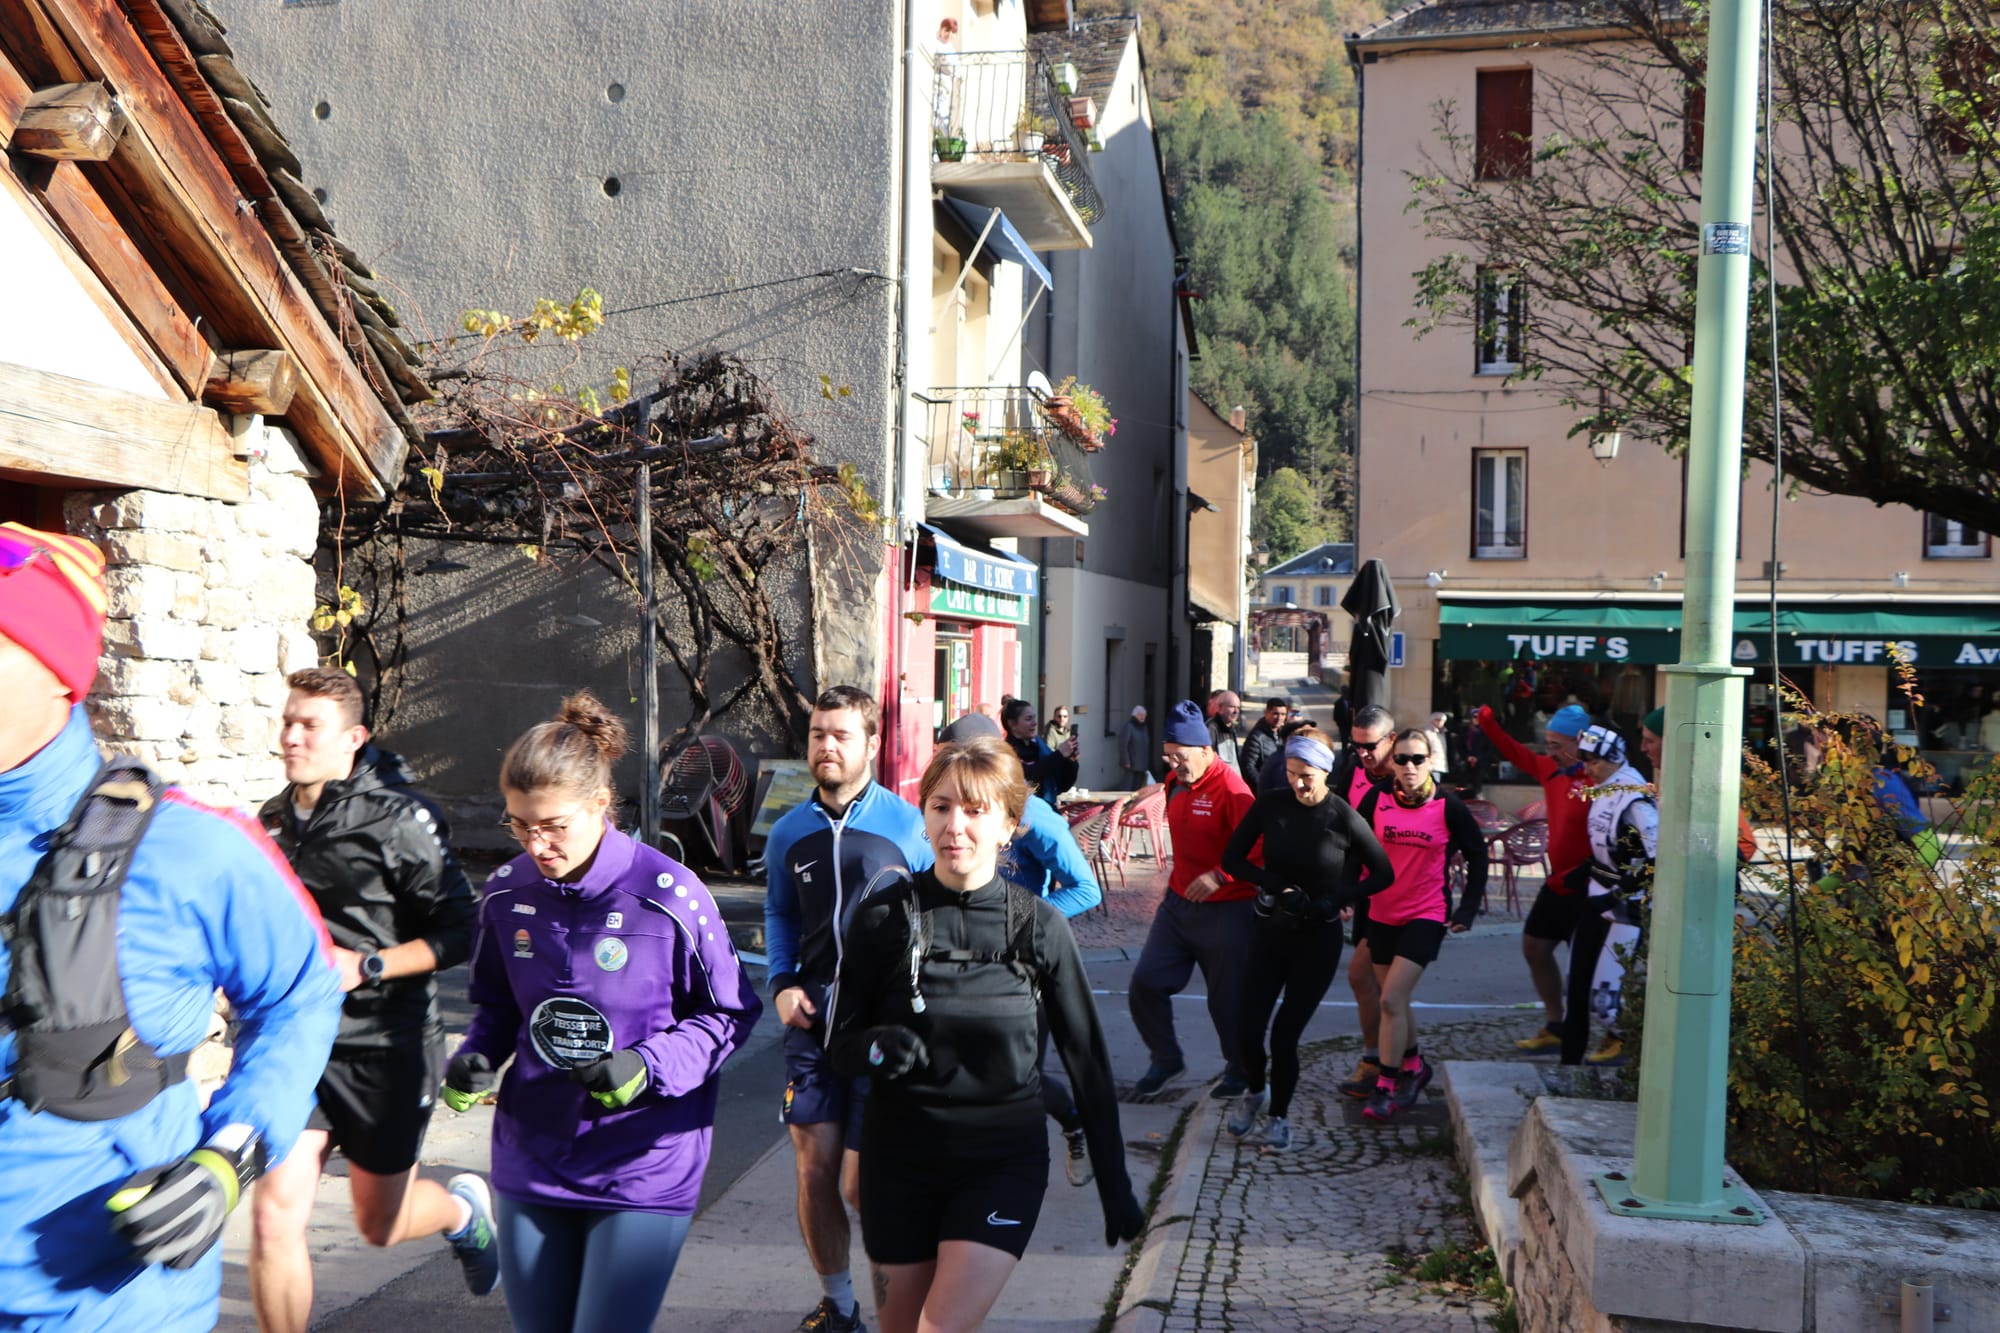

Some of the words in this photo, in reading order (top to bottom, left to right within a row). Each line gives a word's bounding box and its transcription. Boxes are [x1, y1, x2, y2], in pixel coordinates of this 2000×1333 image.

[963, 558, 977, 582] BAR
[984, 564, 993, 587] LE
[1507, 634, 1629, 659] TUFF'S
[1954, 642, 2000, 664] Av
[551, 1035, 607, 1050] TRANSPORTS
